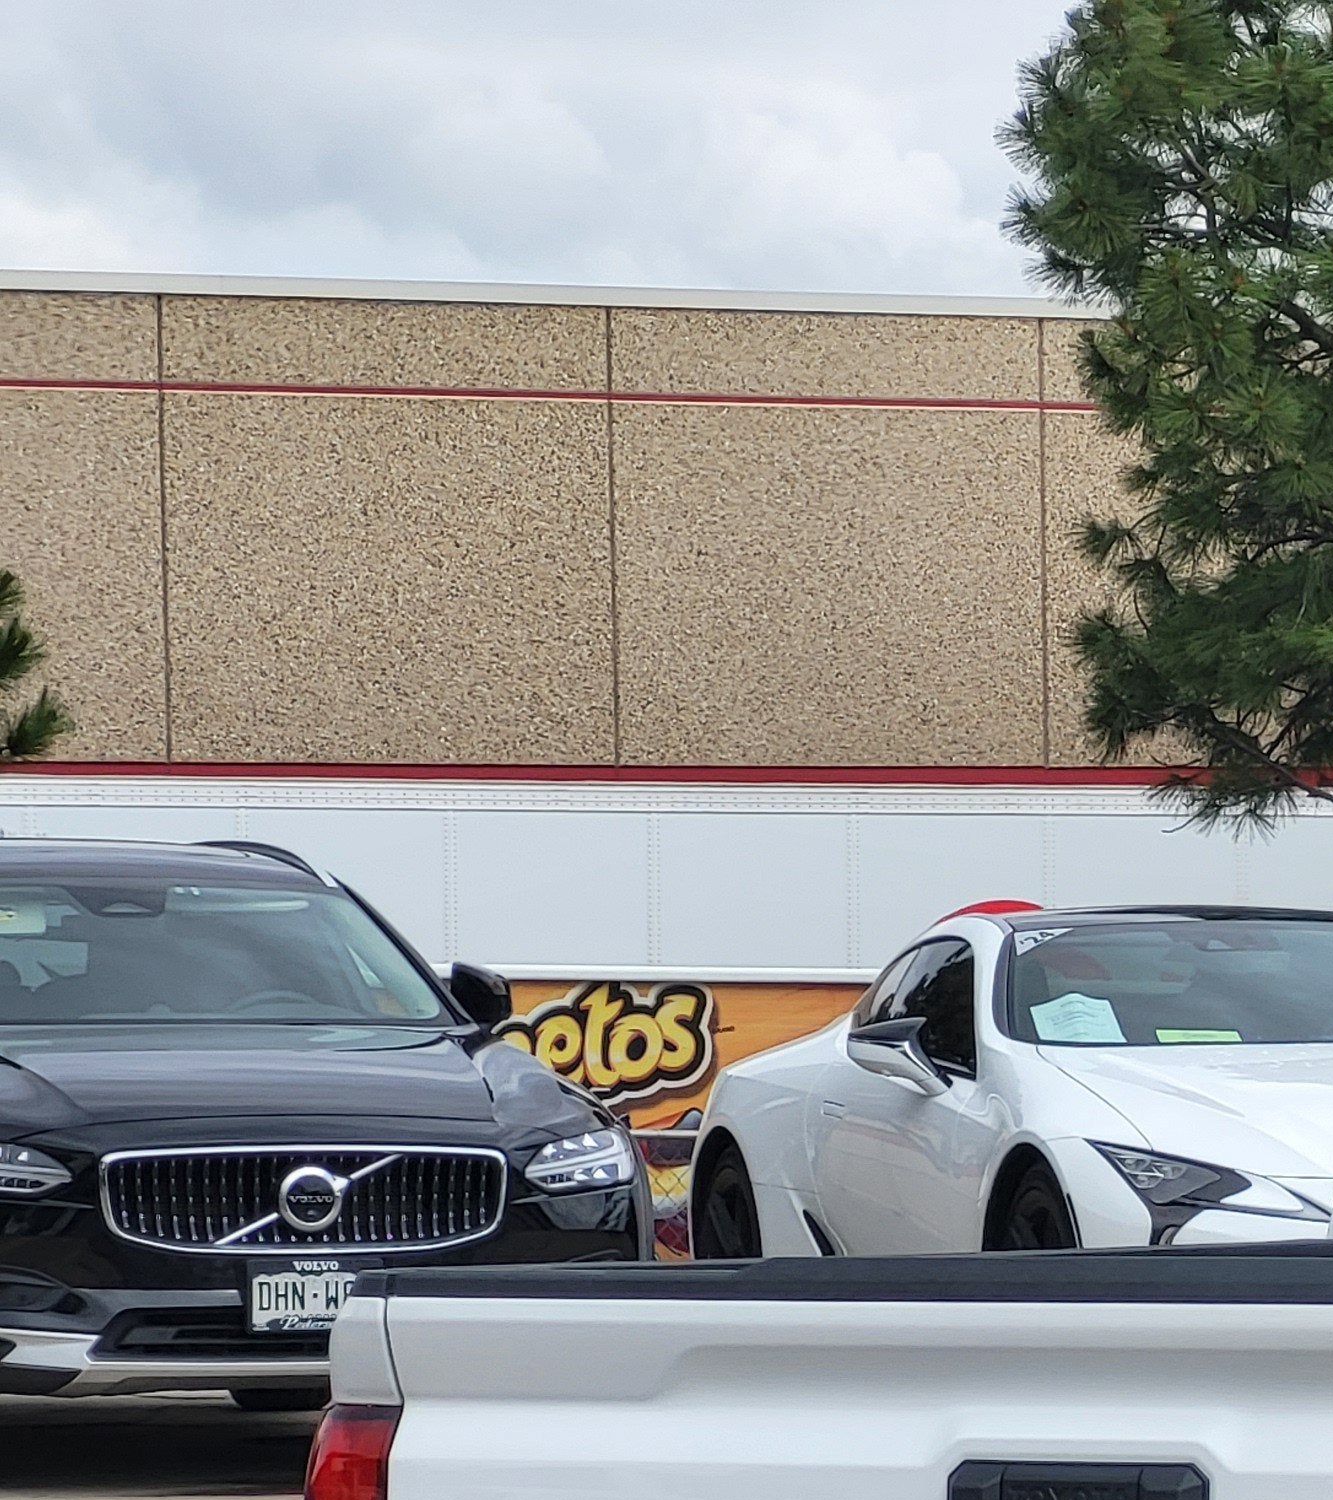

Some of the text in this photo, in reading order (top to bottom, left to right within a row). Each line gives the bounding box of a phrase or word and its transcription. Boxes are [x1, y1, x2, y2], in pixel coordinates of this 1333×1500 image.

[503, 981, 698, 1087] etos
[288, 1195, 334, 1204] VOLVO
[292, 1260, 339, 1271] VOLVO
[257, 1281, 306, 1311] DHN
